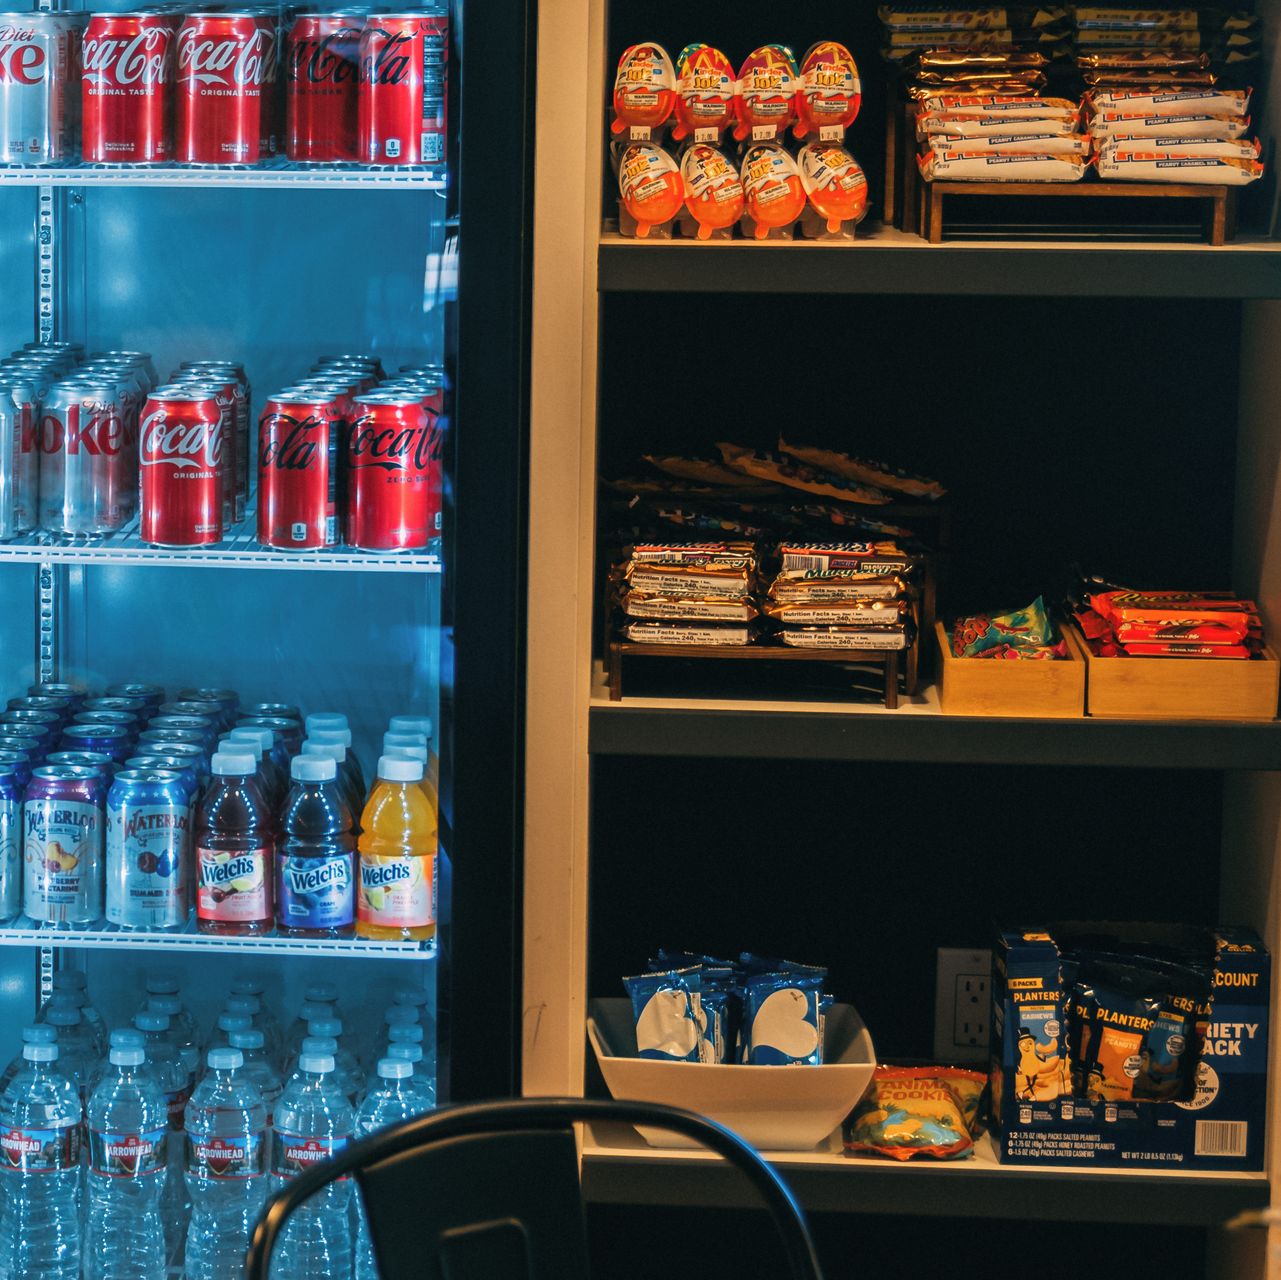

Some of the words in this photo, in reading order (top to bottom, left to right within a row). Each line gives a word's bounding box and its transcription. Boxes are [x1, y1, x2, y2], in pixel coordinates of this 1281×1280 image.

[628, 61, 654, 69] Kinder
[816, 63, 846, 73] Kinder
[694, 68, 721, 76] Kinder
[753, 68, 782, 76] Kinder
[88, 88, 126, 96] ORIGINAL
[82, 400, 117, 416] Diet
[632, 573, 659, 582] Nutrition
[661, 575, 679, 583] Facts
[203, 858, 254, 882] Welch's
[293, 863, 344, 889] Welch's
[361, 864, 410, 885] Welch's
[1216, 973, 1259, 987] COUNT
[1014, 992, 1059, 1002] PLANTERS
[1206, 1023, 1259, 1039] RIETY
[1202, 1040, 1241, 1056] ACK
[109, 1144, 152, 1156] ARROWHEAD
[197, 1147, 243, 1159] ARROWHEAD
